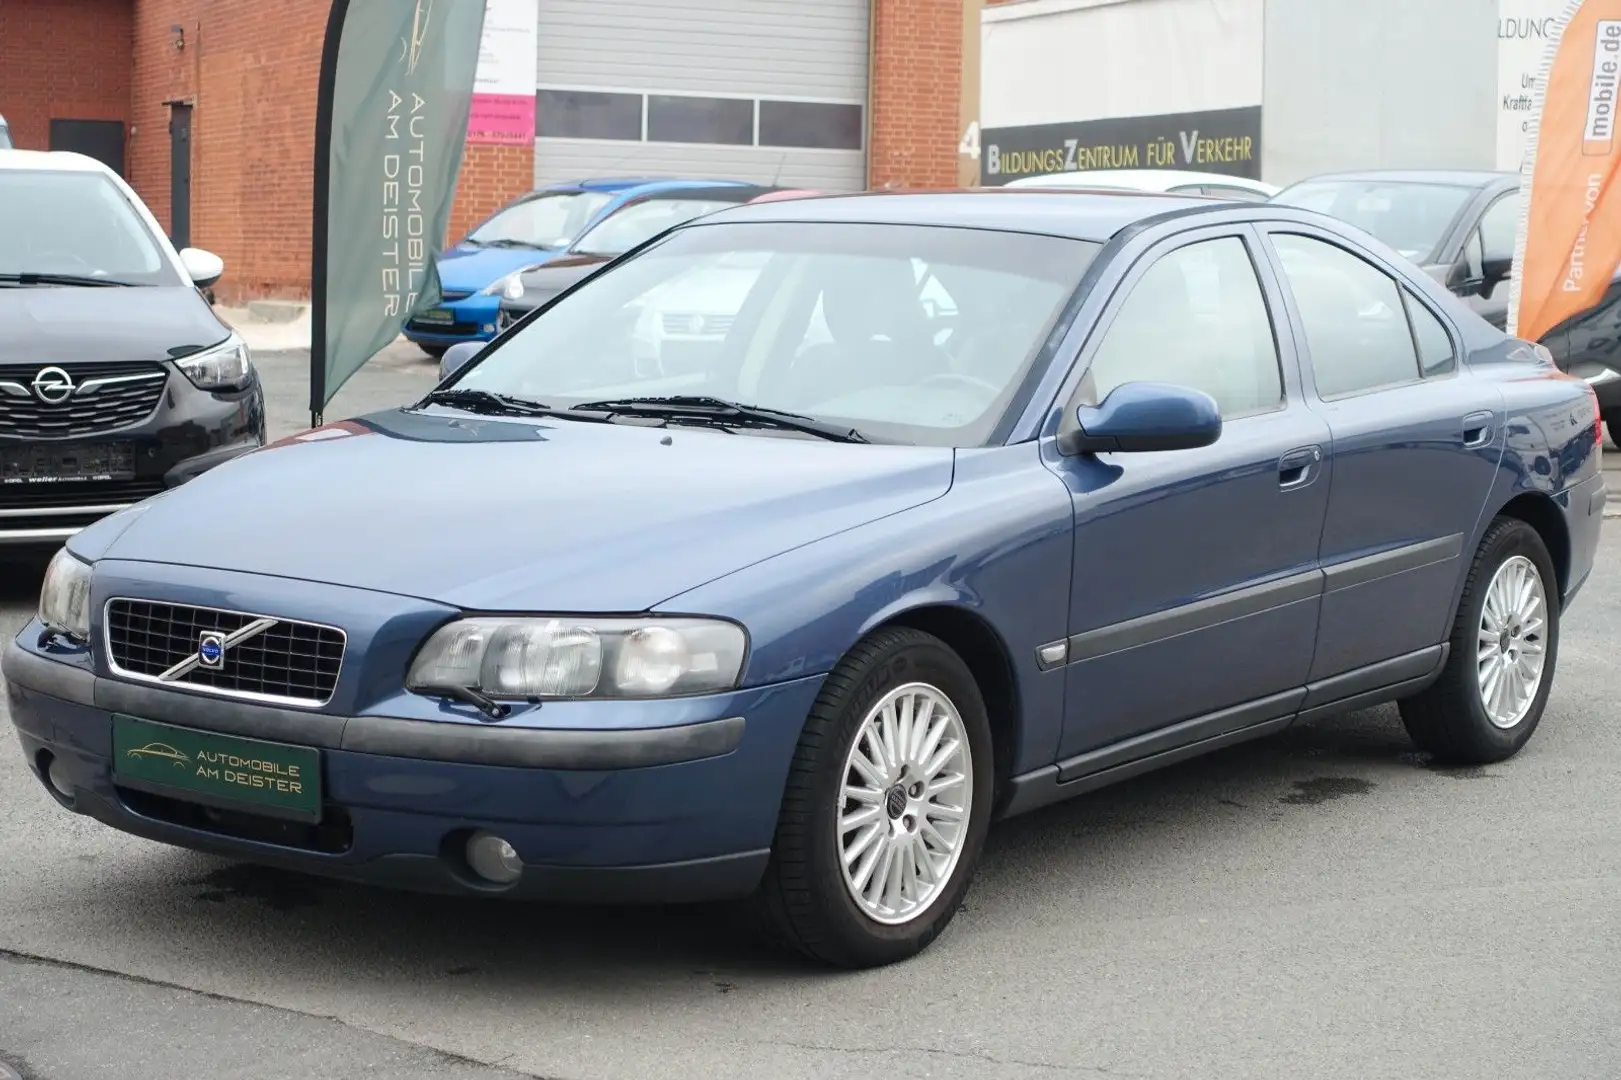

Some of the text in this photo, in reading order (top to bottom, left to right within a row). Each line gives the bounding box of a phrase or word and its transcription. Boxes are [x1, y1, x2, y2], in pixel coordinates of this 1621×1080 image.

[1592, 25, 1621, 137] mobile.de
[959, 121, 981, 159] 4
[1147, 136, 1176, 165] FÜR
[1180, 130, 1252, 163] VERKEHR
[382, 89, 402, 317] AM DEISTER
[405, 92, 426, 313] AUTOMOBILE
[1583, 173, 1603, 214] von
[196, 765, 302, 794] AM DEISTER
[197, 750, 300, 777] AUTOMOBILE
